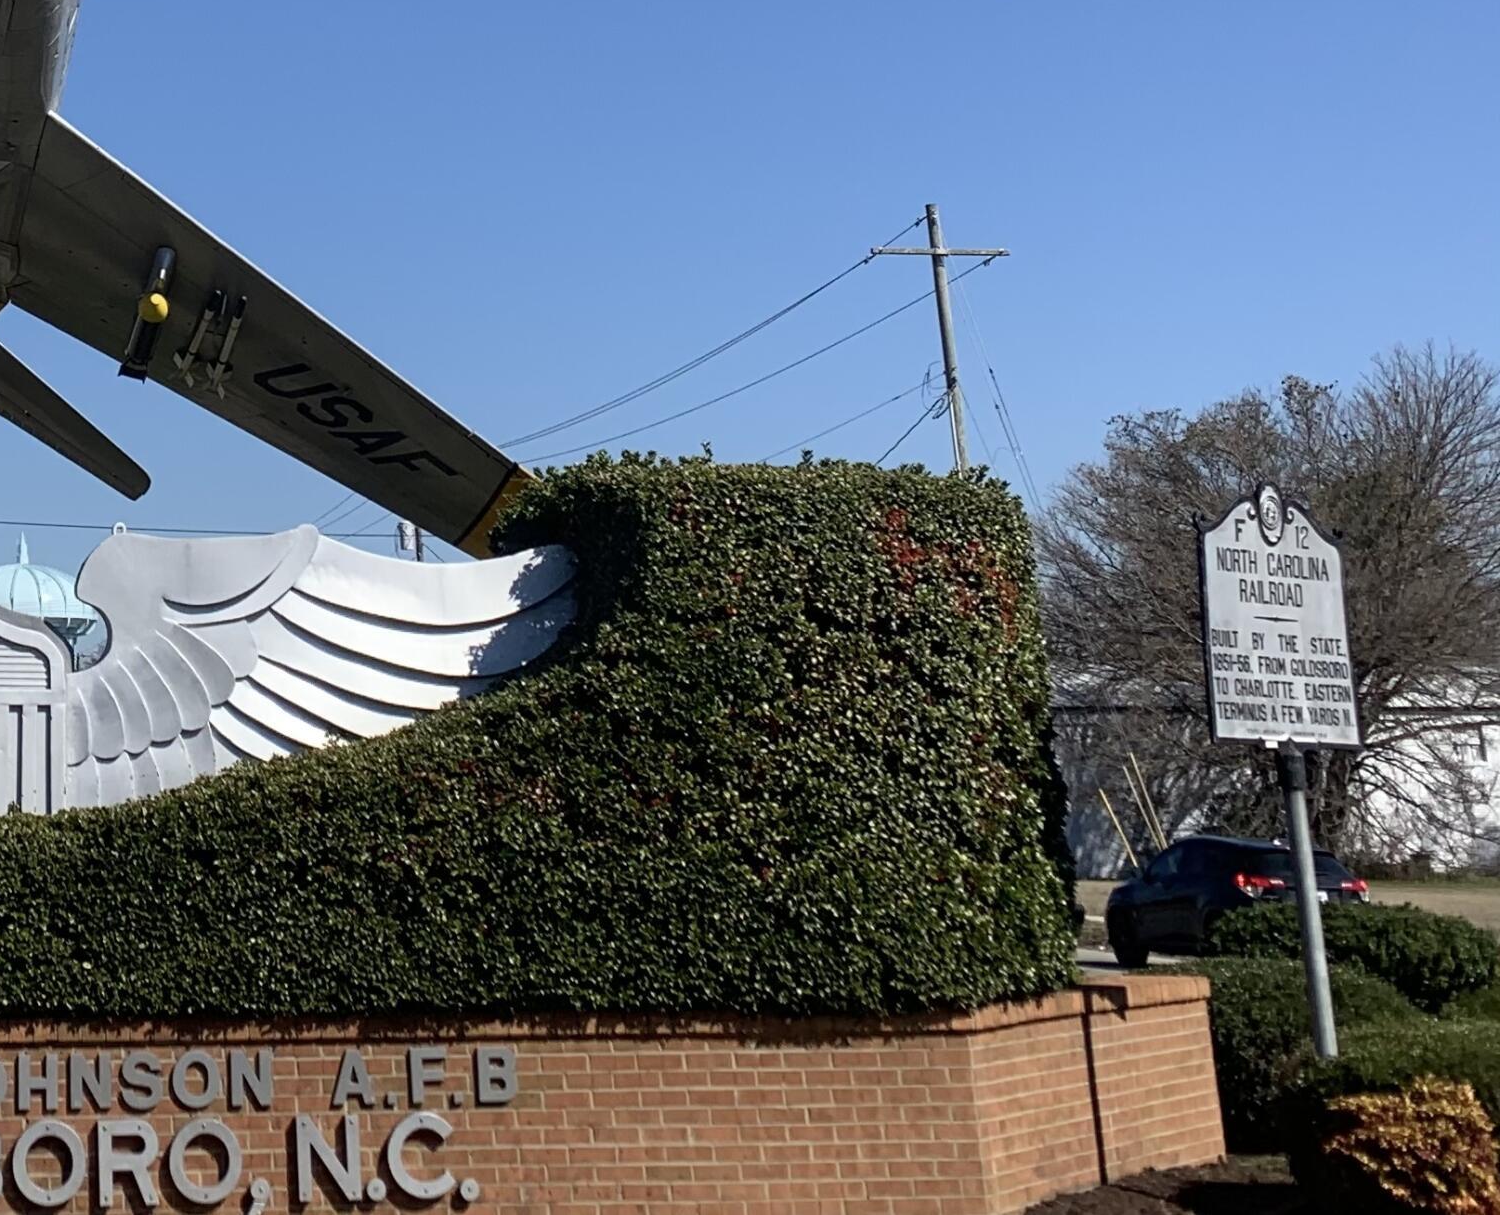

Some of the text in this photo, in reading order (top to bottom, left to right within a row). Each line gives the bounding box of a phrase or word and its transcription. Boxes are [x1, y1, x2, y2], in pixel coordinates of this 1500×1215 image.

[253, 362, 458, 478] USAF
[1234, 518, 1310, 550] F 12
[1216, 546, 1330, 582] NORTH CAROLINA
[1239, 578, 1304, 608] RAILROAD
[1211, 628, 1239, 649] BUILT
[1251, 631, 1265, 651] BY
[1277, 633, 1300, 654] THE
[1257, 655, 1287, 676] FROM
[1290, 658, 1349, 680] GOLDSBORO
[1214, 676, 1229, 695] TO
[1304, 682, 1352, 703] EASTERN
[1216, 701, 1268, 723] TERMINUS
[1271, 704, 1279, 723] A
[1280, 705, 1303, 724] FEW
[1307, 706, 1340, 727] YARDS
[298, 1110, 480, 1203] N.C.
